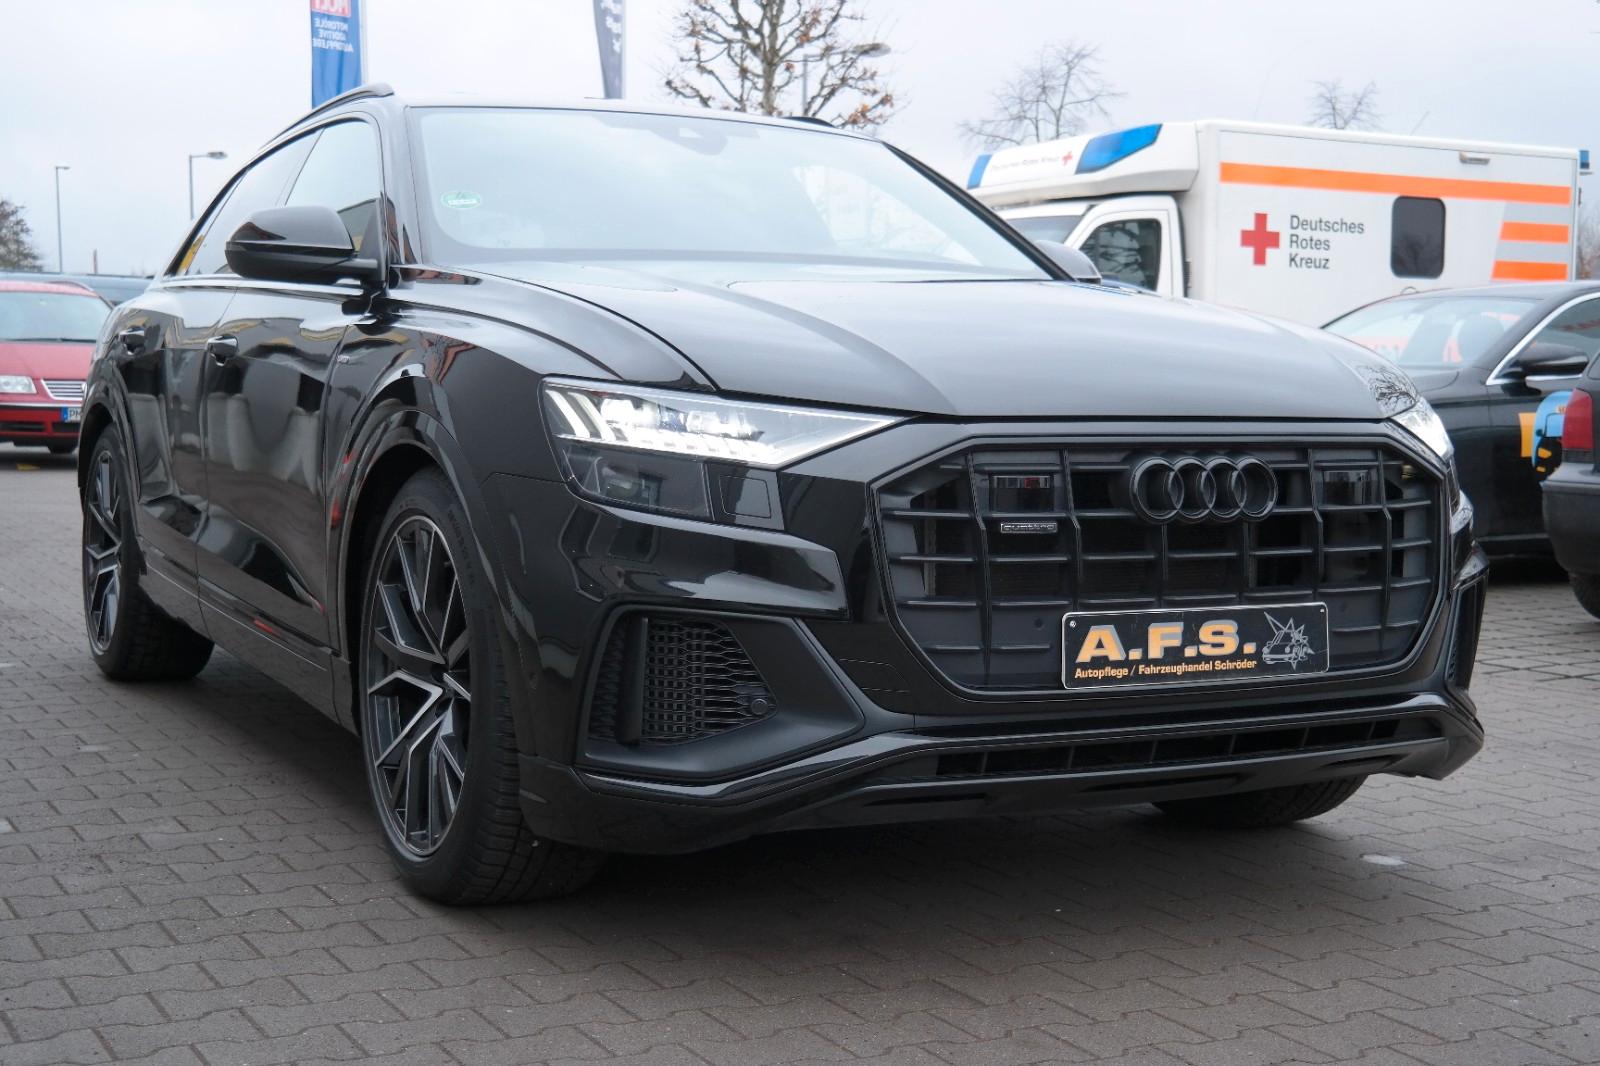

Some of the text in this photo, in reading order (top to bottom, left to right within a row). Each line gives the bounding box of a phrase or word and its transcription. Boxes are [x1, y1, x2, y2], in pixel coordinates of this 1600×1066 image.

[1290, 214, 1365, 234] Deutsches
[1290, 234, 1331, 251] Rotes
[1289, 253, 1330, 270] Kreuz
[1075, 619, 1257, 663] A.F.S.
[1074, 659, 1257, 680] Autopflege / Fahrzeughandel Schröder
